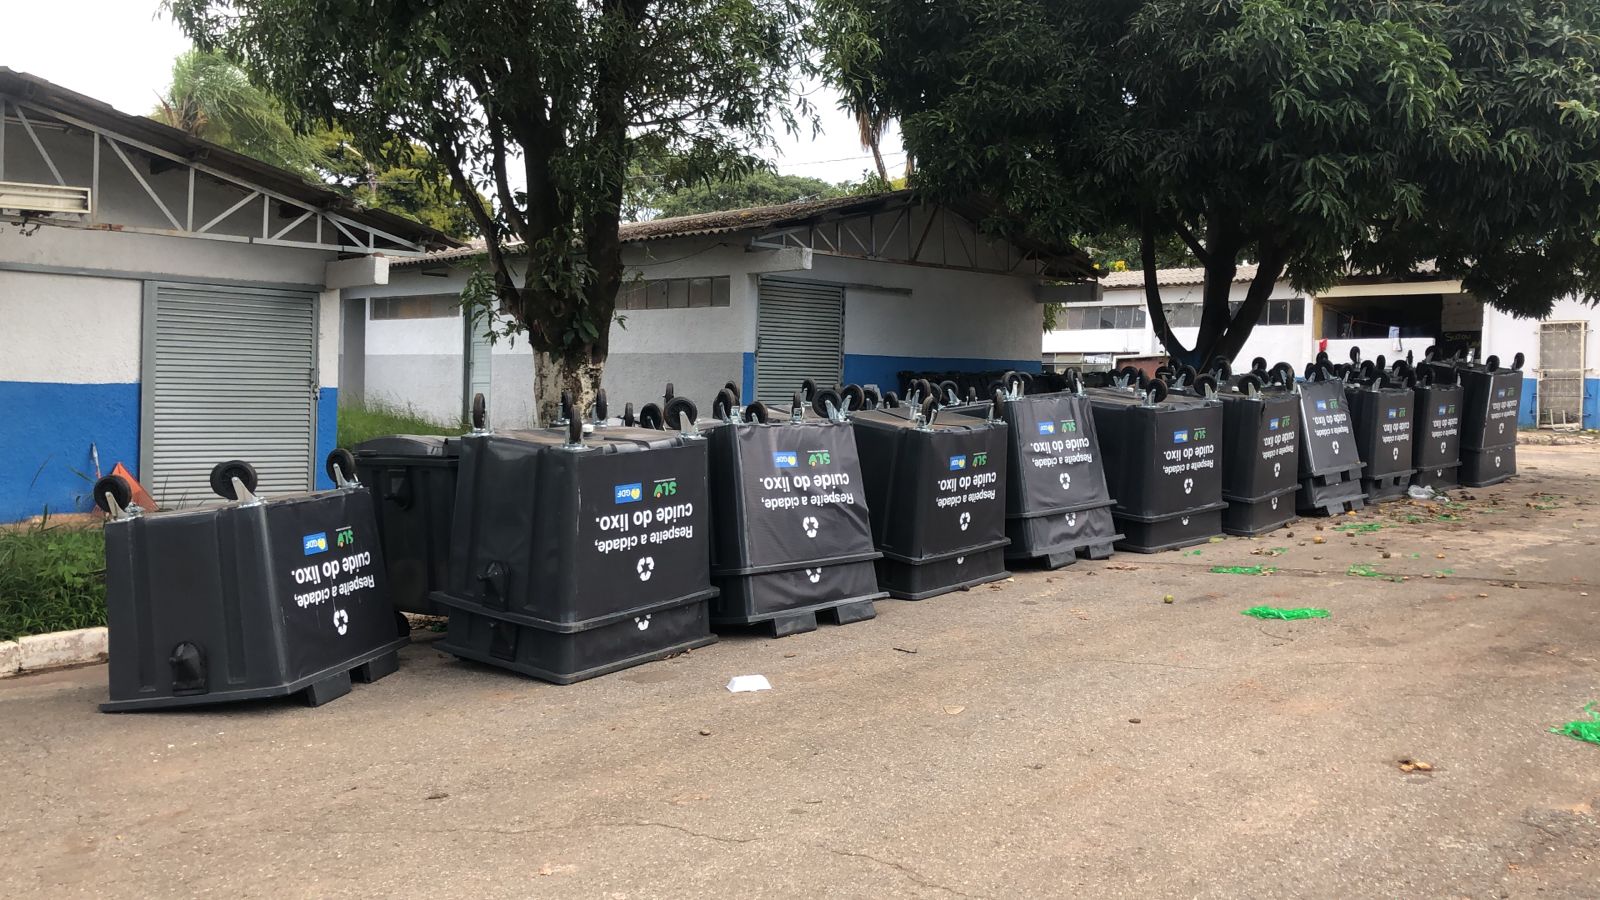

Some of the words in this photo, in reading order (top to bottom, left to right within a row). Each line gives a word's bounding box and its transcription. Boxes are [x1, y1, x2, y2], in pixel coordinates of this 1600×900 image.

[1030, 442, 1051, 454] lixo.
[1052, 441, 1063, 452] do
[1066, 438, 1089, 451] cuide
[1195, 444, 1214, 458] cuide
[1065, 452, 1092, 464] Respeite
[1164, 450, 1181, 462] lixo.
[1183, 448, 1193, 460] do
[1032, 458, 1057, 468] cidade,
[1163, 464, 1185, 475] cidade,
[1191, 459, 1214, 470] Respeite
[760, 476, 790, 492] lixo.
[794, 475, 810, 491] do
[813, 473, 849, 490] cuide
[938, 478, 957, 492] lixo.
[960, 476, 971, 490] do
[973, 472, 996, 487] cuide
[617, 489, 630, 498] GDF
[802, 496, 807, 505] a
[810, 492, 854, 506] Respeite
[968, 489, 995, 502] Respeite
[761, 497, 799, 510] cidade,
[936, 496, 961, 508] cidade,
[633, 510, 652, 527] do
[656, 503, 693, 524] cuide
[596, 514, 628, 531] lixo.
[641, 534, 647, 544] a
[650, 525, 693, 544] Respeite
[305, 539, 317, 549] GDF
[595, 535, 638, 554] cidade,
[323, 560, 339, 579] do
[342, 551, 370, 574] cuide
[291, 565, 320, 584] lixo.
[332, 586, 337, 597] a
[339, 575, 374, 596] Respeite
[294, 588, 330, 608] cidade,
